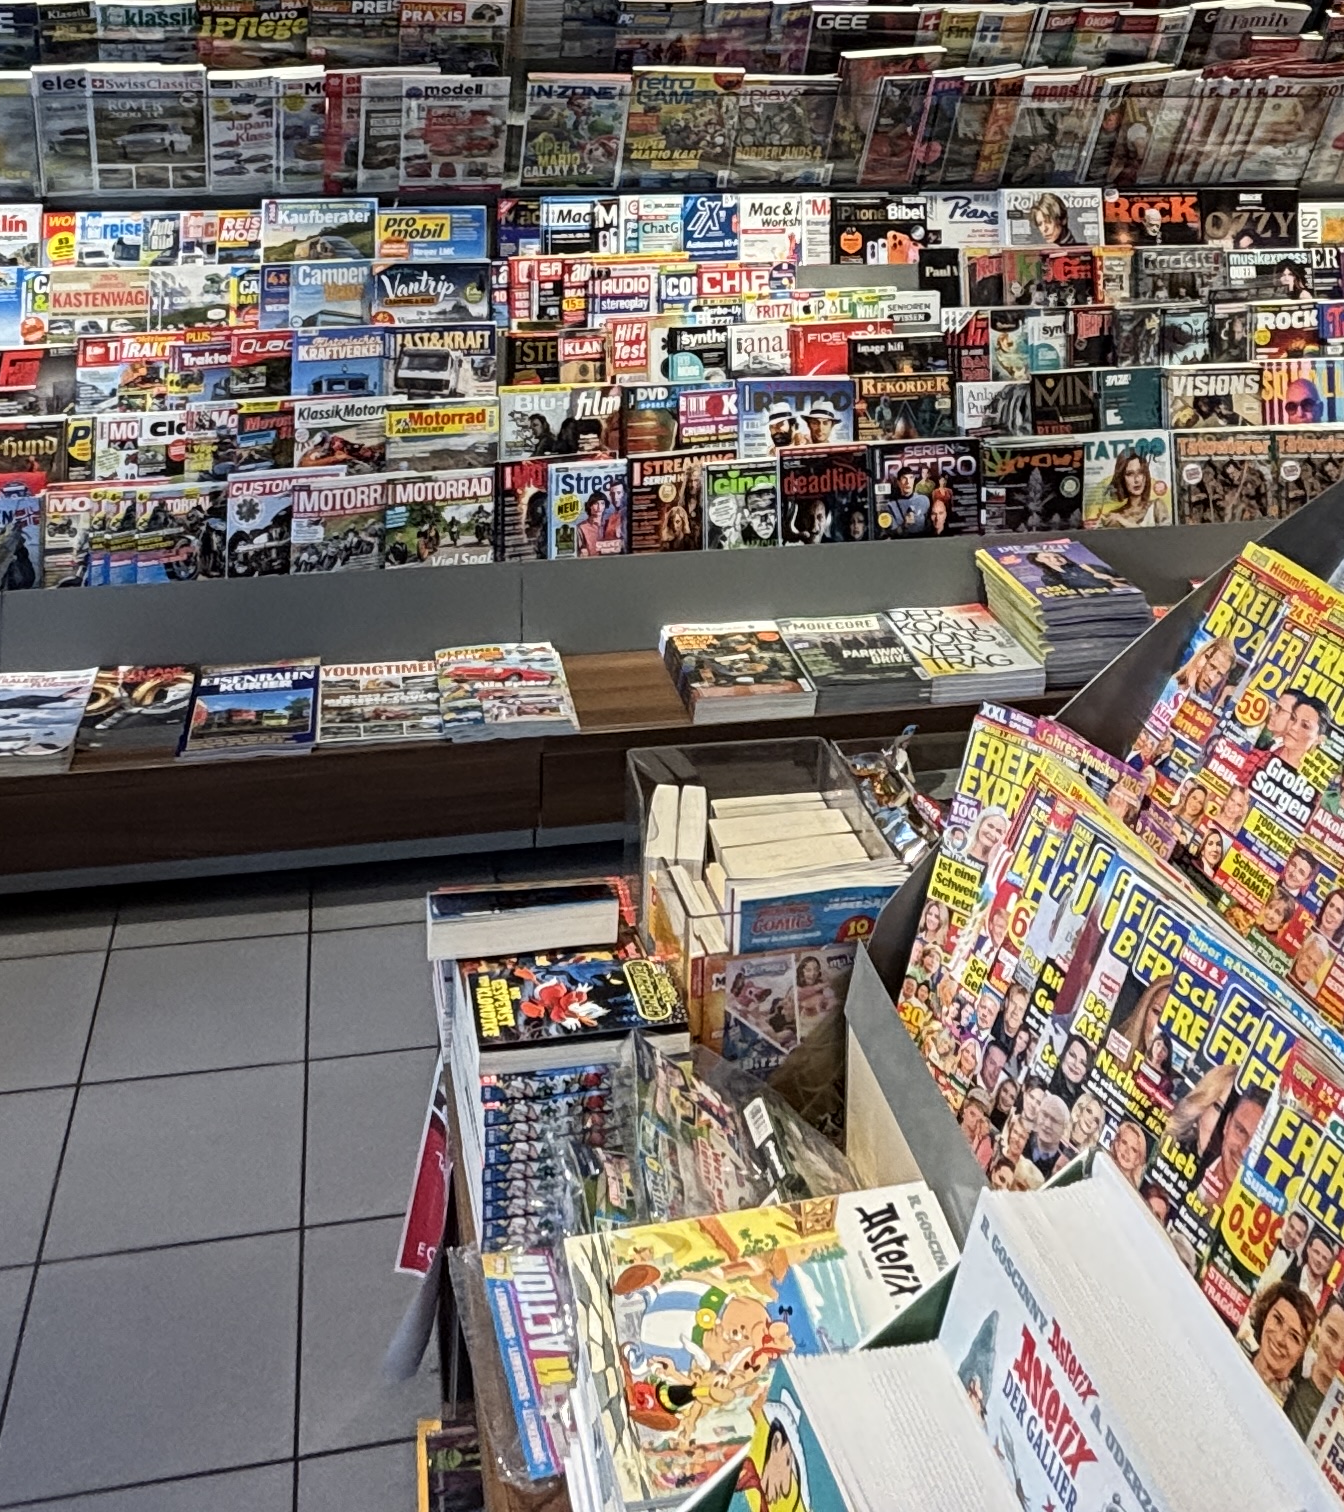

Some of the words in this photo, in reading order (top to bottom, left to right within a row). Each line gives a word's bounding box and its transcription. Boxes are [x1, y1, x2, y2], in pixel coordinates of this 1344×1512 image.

[402, 9, 463, 23] PRAXIS
[816, 14, 868, 30] GEE
[105, 77, 203, 91] SwissClassics
[277, 209, 370, 224] Kaufberater
[887, 202, 925, 221] Bibel
[384, 216, 415, 231] pro
[397, 222, 445, 241] mobil
[1229, 251, 1310, 265] musikexpress
[297, 266, 369, 286] Camper
[701, 270, 769, 294] CHIP
[382, 275, 455, 300] Vantrip
[601, 295, 649, 312] stereoplay
[1258, 309, 1318, 330] ROCK
[883, 342, 904, 353] hifi
[861, 377, 950, 395] REKORDER
[1172, 374, 1260, 396] VISIONS
[408, 410, 486, 427] Motorrad
[395, 478, 492, 502] MOTORRAD
[557, 502, 580, 515] NEU!
[1270, 560, 1323, 607] Himmlische
[886, 608, 944, 624] DER
[791, 620, 875, 631] MORECORE
[896, 619, 978, 634] KOALI
[908, 630, 998, 646] TIONS
[841, 646, 906, 660] PARKWAY
[871, 653, 912, 664] DRIVE
[925, 644, 976, 658] VER
[322, 661, 438, 677] YOUNGTIMER
[921, 653, 1014, 672] TRAG
[201, 671, 314, 688] EISENBAHN
[220, 680, 294, 692] KURIER
[980, 702, 1008, 723] XXL
[1265, 757, 1317, 804] Große
[1252, 771, 1311, 824] Sorgen
[1242, 1170, 1287, 1214] Super!
[856, 1202, 922, 1299] Asterix
[991, 1234, 1048, 1334] GOSCINNY
[1048, 1317, 1100, 1406] Asterix
[1013, 1323, 1098, 1479] Asterix
[1003, 1369, 1026, 1427] DER
[1026, 1418, 1078, 1512] GALLIER
